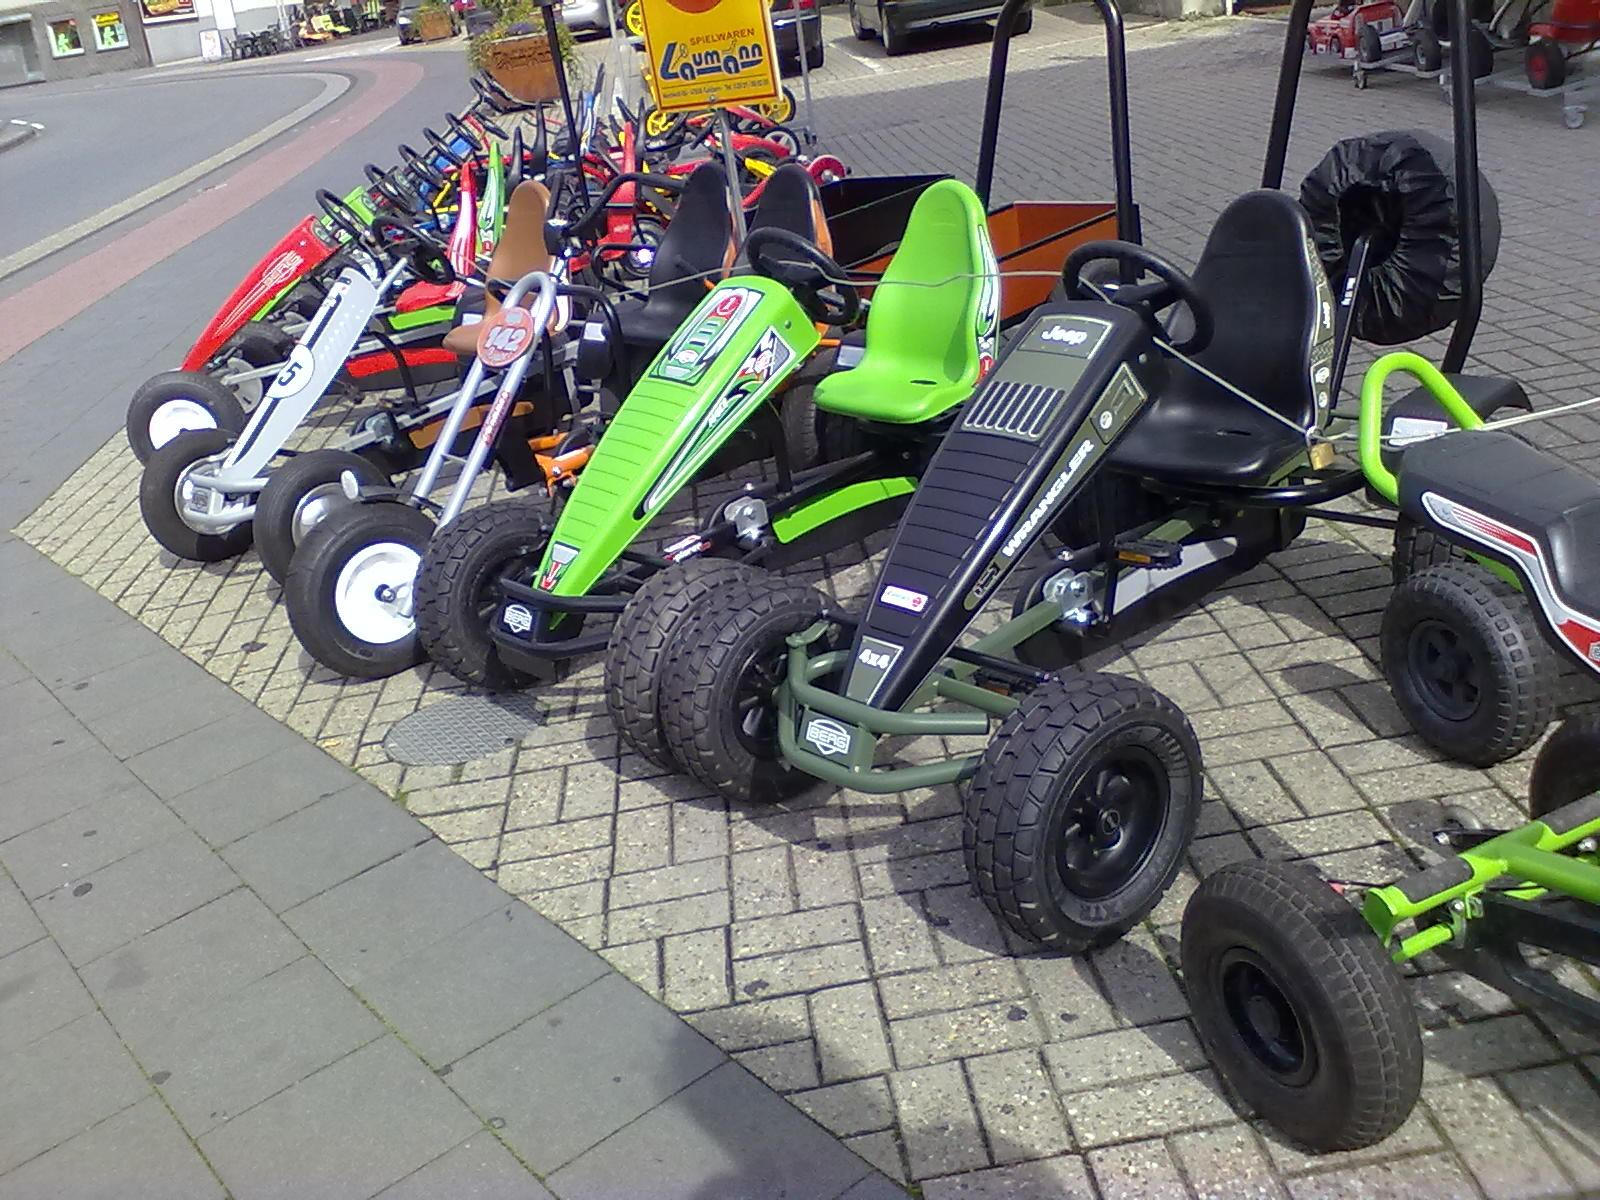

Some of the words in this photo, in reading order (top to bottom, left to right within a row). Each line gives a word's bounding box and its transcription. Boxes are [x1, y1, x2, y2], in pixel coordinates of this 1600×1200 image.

[690, 28, 755, 46] SPIELWAREN
[660, 42, 763, 80] Laumann
[485, 326, 527, 352] 142
[1041, 325, 1088, 345] Jeep
[278, 361, 303, 387] 5
[1002, 439, 1094, 557] WRANGLER
[859, 648, 890, 669] 4x4
[808, 724, 849, 752] BERG
